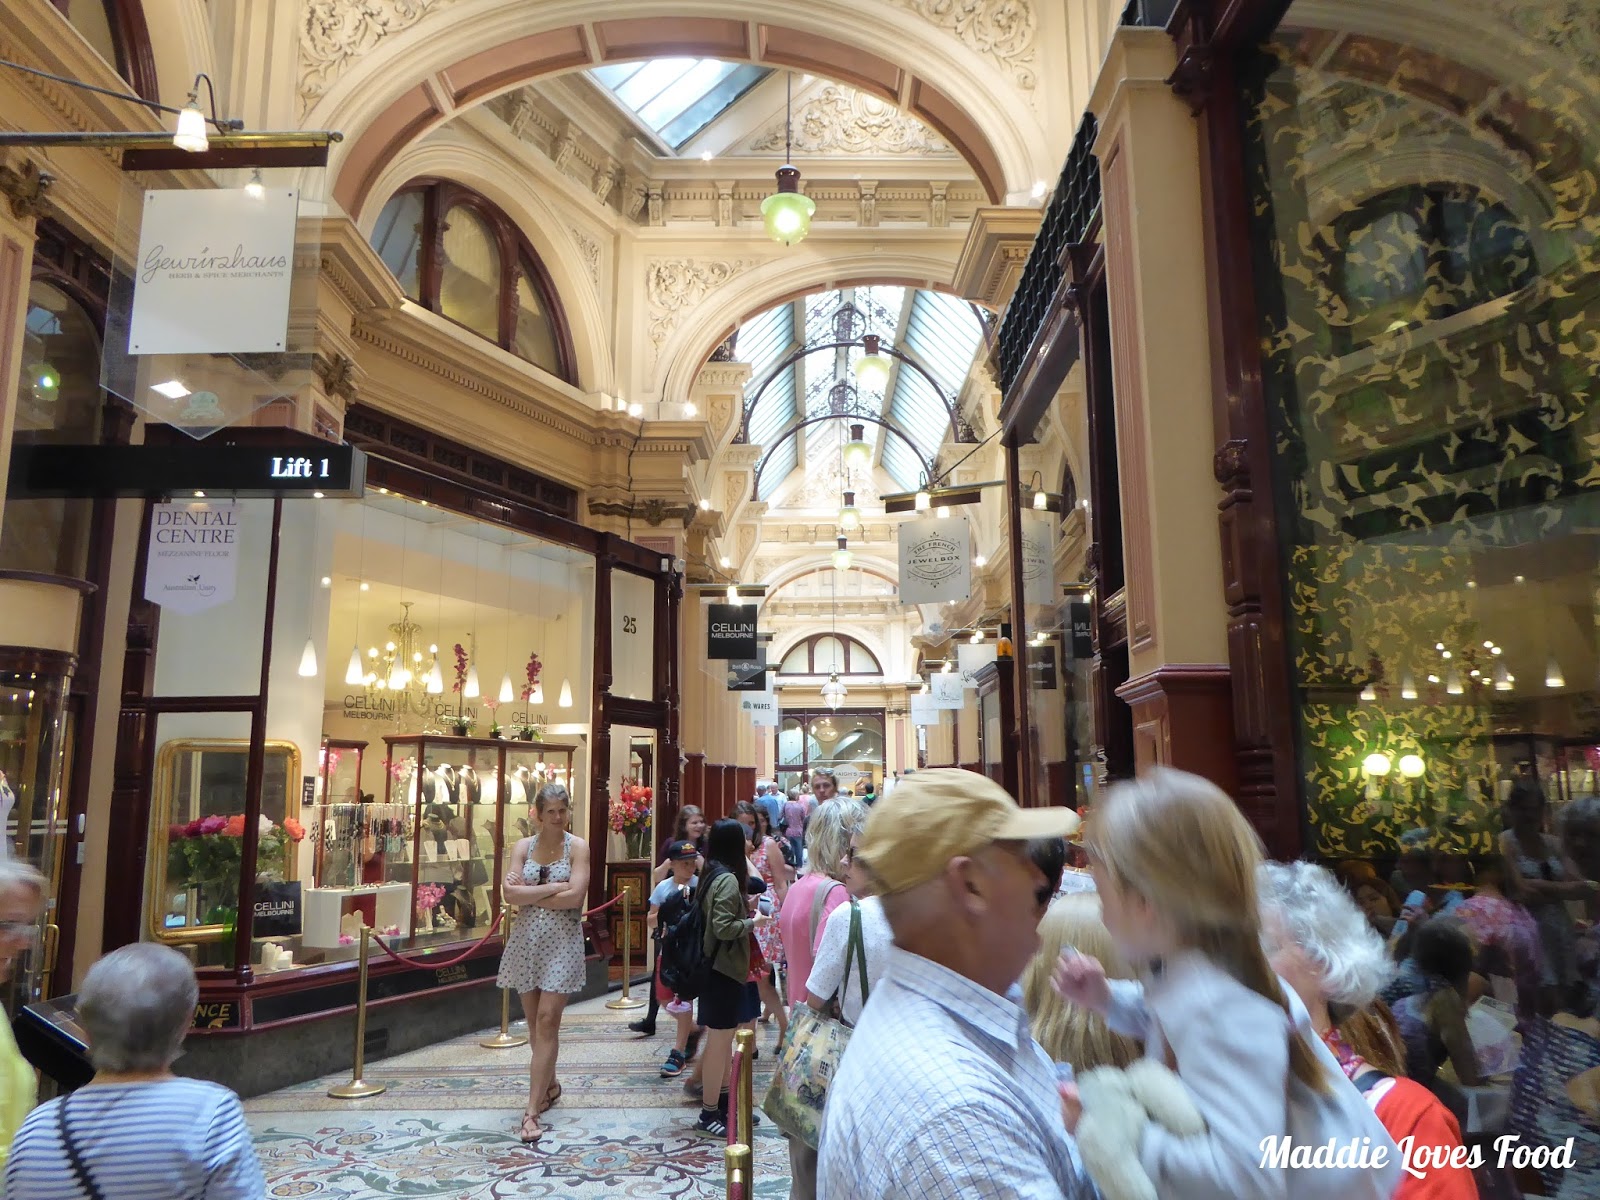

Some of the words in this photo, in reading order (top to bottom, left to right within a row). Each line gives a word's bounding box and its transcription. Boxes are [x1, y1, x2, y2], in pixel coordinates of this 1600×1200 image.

[141, 243, 286, 283] Gewürzhaus
[271, 457, 313, 477] Lift
[319, 458, 329, 477] 1
[157, 511, 237, 526] DENTAL
[156, 529, 234, 544] CENTRE
[928, 541, 955, 552] FRENCH
[907, 555, 960, 565] JEWELBOX
[622, 615, 637, 634] 25
[711, 623, 754, 632] CELLINI
[344, 695, 395, 711] CELLINI
[343, 710, 394, 721] MELBOURNE
[435, 703, 478, 719] CELLINI
[511, 711, 548, 725] CELLINI
[434, 717, 477, 728] MELBONE
[254, 900, 295, 912] CELLINI
[254, 909, 294, 918] MELBOURNE
[195, 1003, 231, 1018] NCE
